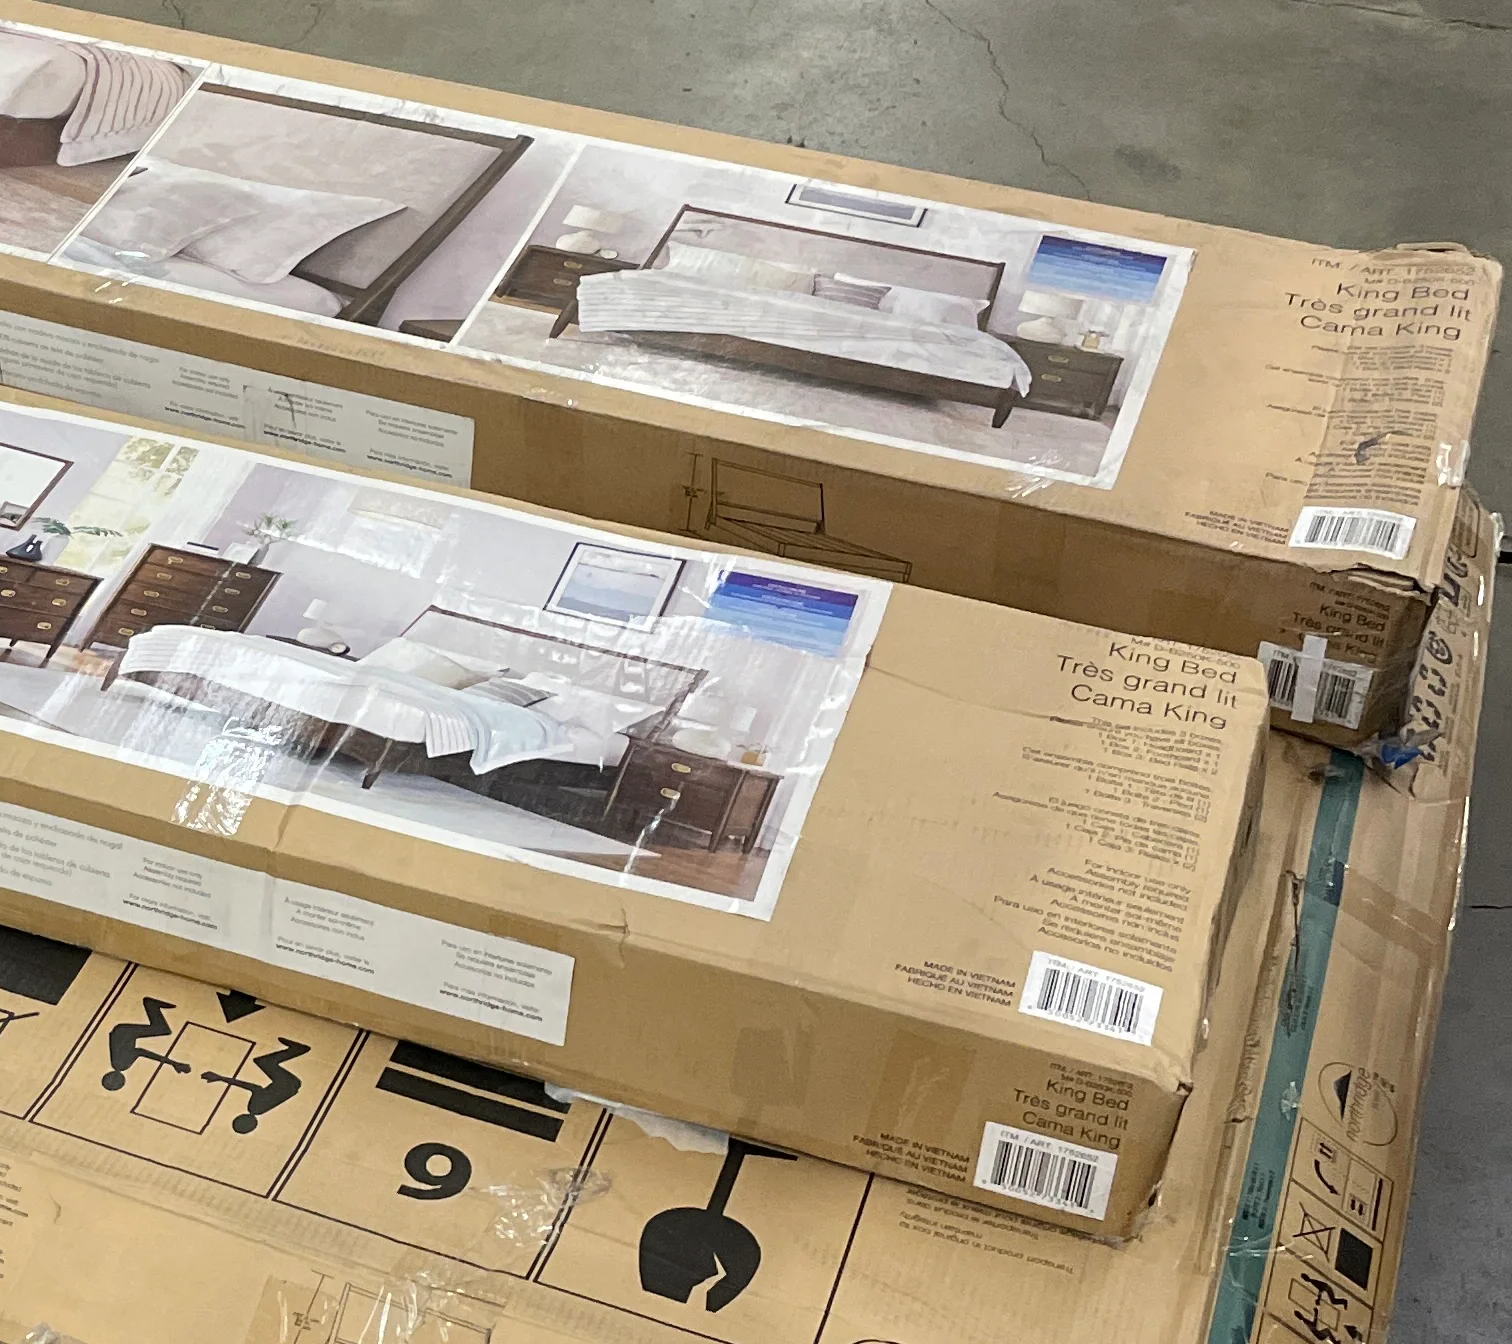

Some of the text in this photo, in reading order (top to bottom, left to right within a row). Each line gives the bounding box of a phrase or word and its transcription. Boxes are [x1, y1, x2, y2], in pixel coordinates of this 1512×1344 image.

[1284, 291, 1472, 329] Très grand lit
[1335, 282, 1470, 303] King Bed
[1299, 313, 1461, 341] Cama King
[1056, 653, 1237, 710] Très grand lit
[1107, 641, 1237, 685] King Bed
[1070, 682, 1227, 730] Cama King
[1012, 1086, 1129, 1131] Très grand lit
[1045, 1078, 1130, 1111] King Bed
[1345, 1067, 1372, 1143] northridge
[1021, 1110, 1121, 1151] Cama King
